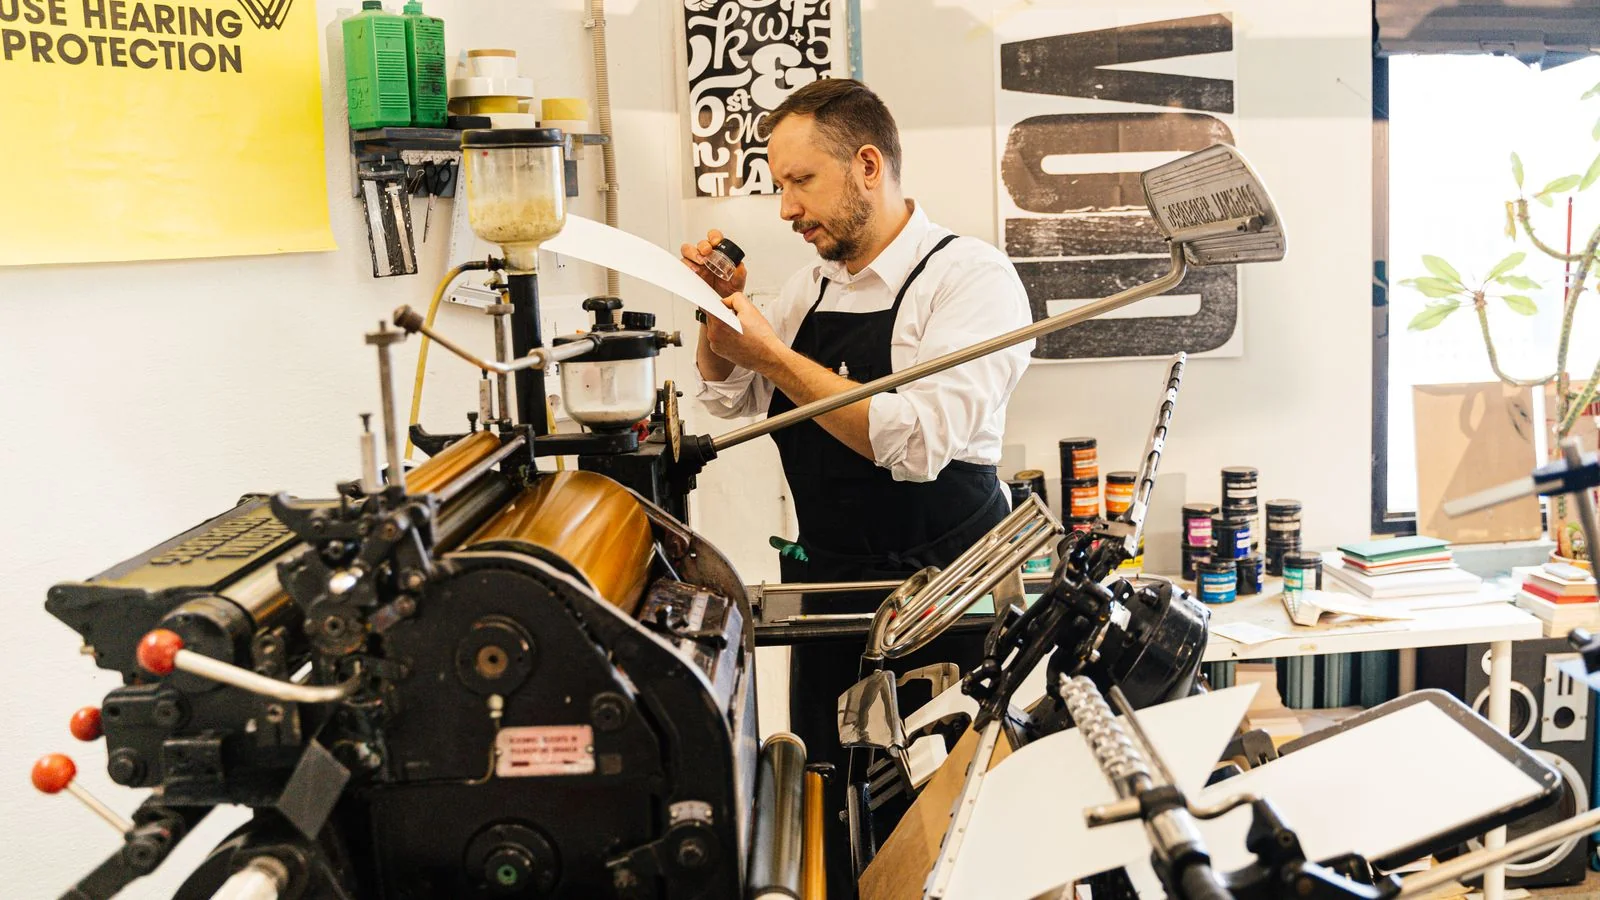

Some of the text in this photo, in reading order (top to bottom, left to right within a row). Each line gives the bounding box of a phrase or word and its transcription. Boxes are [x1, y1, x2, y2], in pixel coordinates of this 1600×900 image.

[0, 0, 243, 39] USE HEARING
[2, 28, 243, 74] PROTECTION
